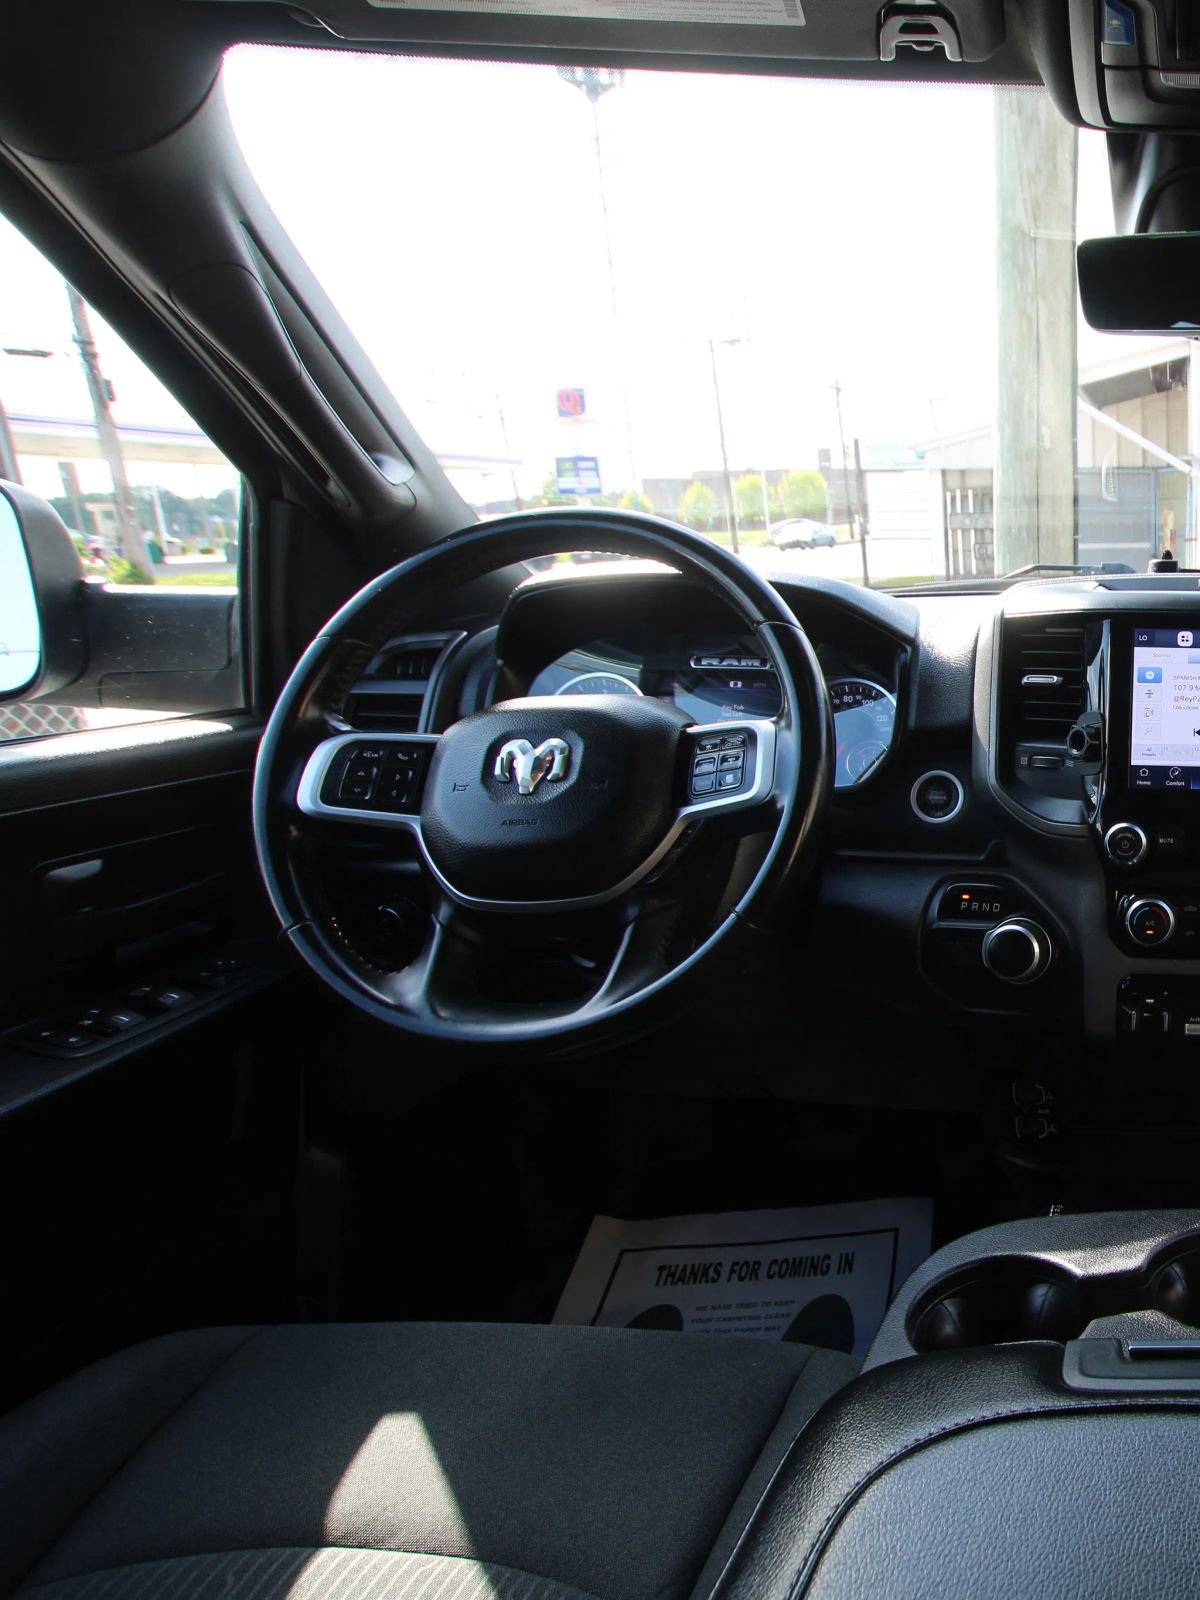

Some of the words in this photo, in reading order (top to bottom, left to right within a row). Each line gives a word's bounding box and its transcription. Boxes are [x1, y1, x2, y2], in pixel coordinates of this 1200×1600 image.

[655, 1262, 723, 1286] THANKS
[727, 1261, 762, 1283] FOR
[766, 1253, 832, 1280] COMING
[837, 1252, 855, 1275] IN
